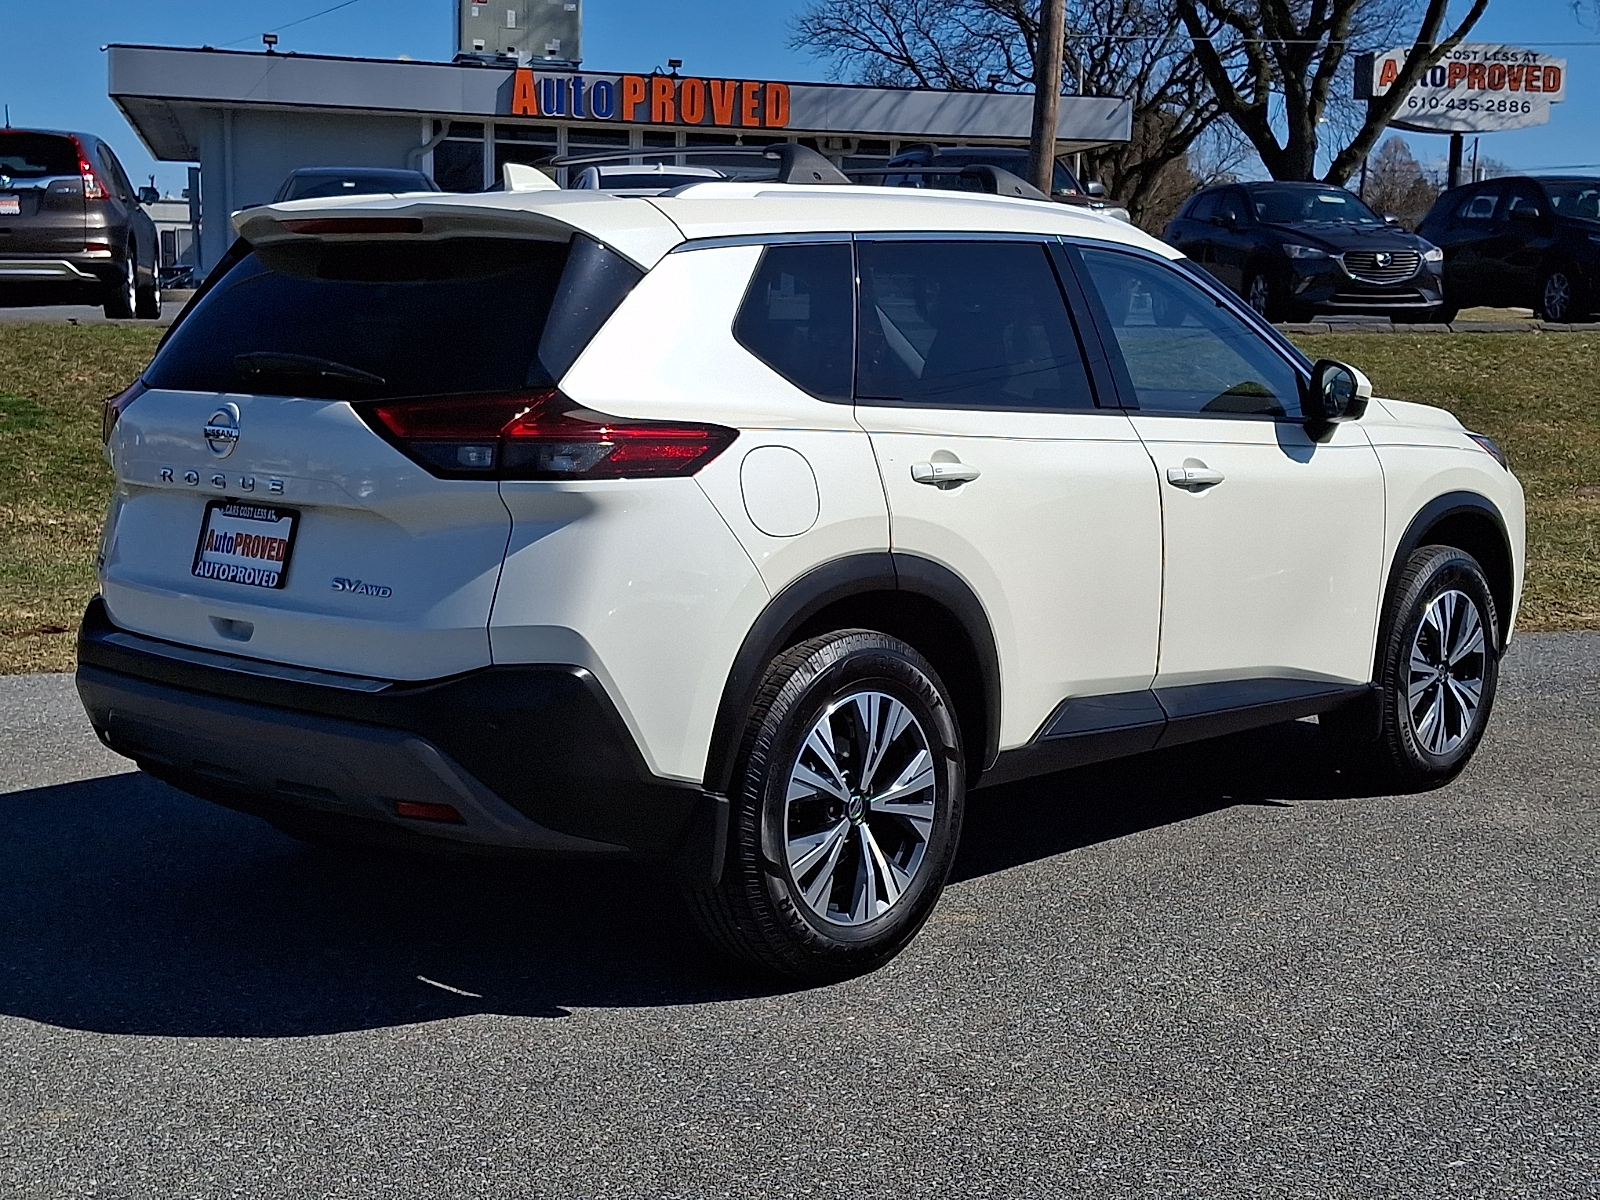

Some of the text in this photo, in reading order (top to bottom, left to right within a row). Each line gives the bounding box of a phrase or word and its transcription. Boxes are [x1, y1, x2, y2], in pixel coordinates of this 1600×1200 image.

[1445, 50, 1539, 63] COST LESS AT
[1379, 59, 1561, 92] AoPROVED
[512, 68, 790, 128] AutoPROVED
[1407, 96, 1531, 114] 610-435-2886
[204, 427, 233, 438] NISSAN
[160, 467, 285, 495] ROGUE
[239, 506, 254, 518] COST
[253, 508, 267, 519] LESS
[205, 528, 288, 562] AutoPROVED
[195, 561, 278, 587] AUTOPROVED
[331, 576, 393, 599] SV AWD
